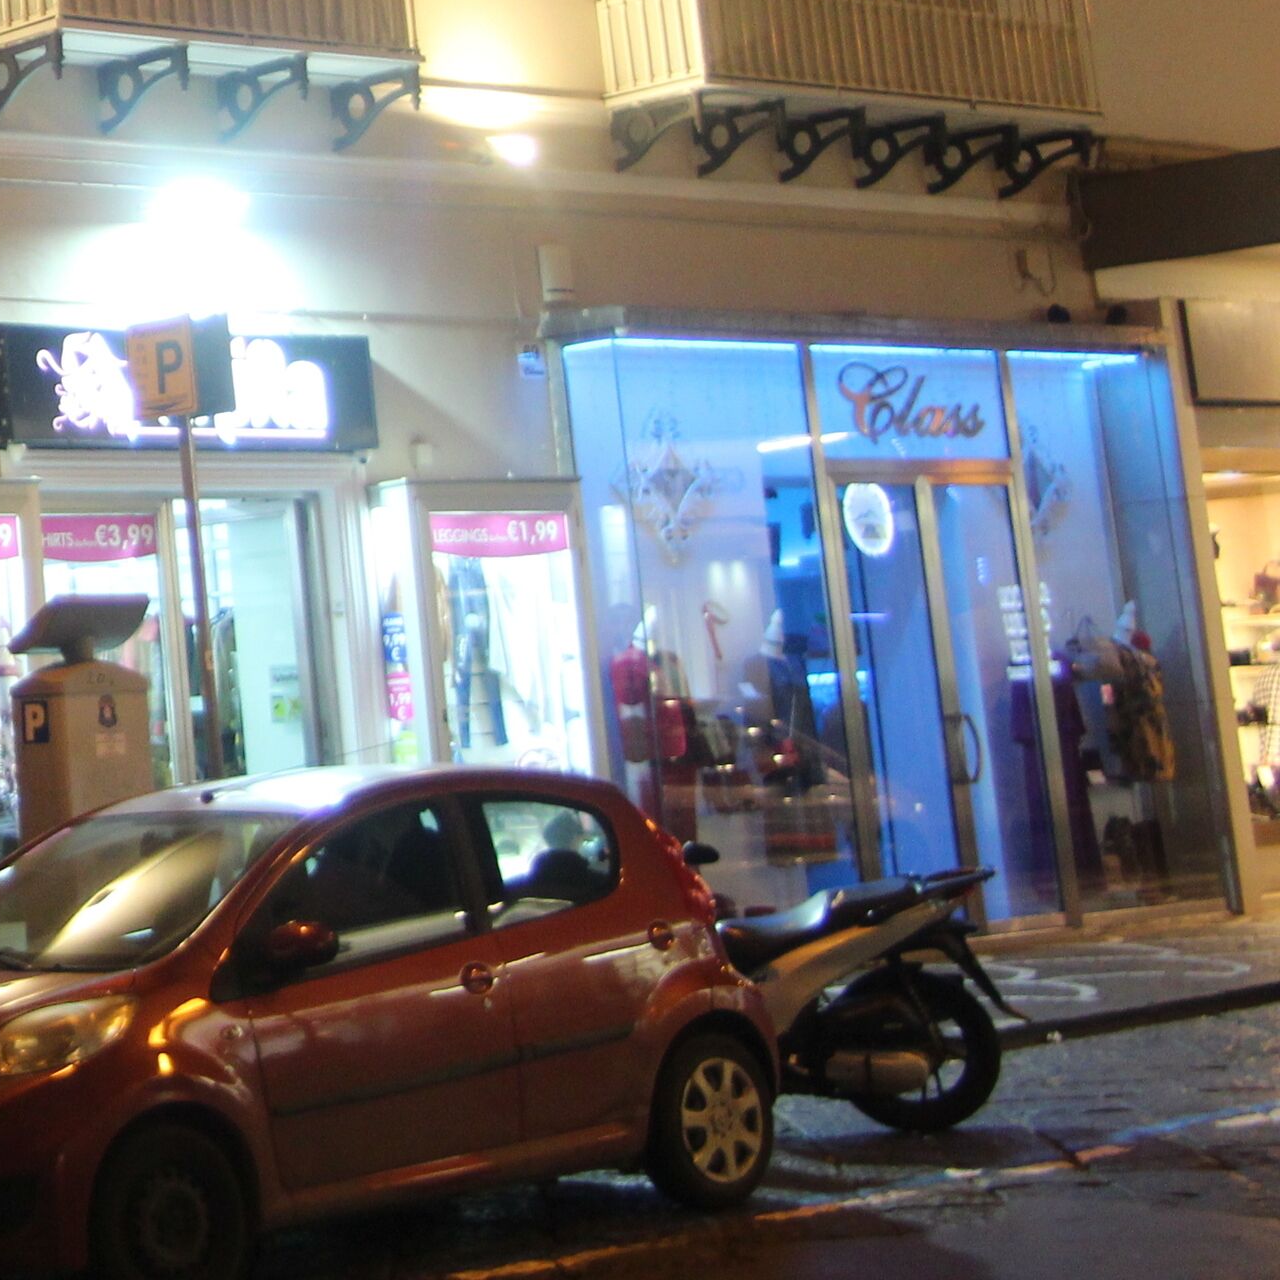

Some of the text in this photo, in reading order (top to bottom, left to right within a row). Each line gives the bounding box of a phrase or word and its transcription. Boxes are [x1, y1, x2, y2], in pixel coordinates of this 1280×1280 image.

[155, 339, 184, 395] P
[837, 361, 986, 444] Class
[95, 523, 154, 550] €3,99
[506, 519, 558, 545] €1,99
[25, 703, 46, 741] P
